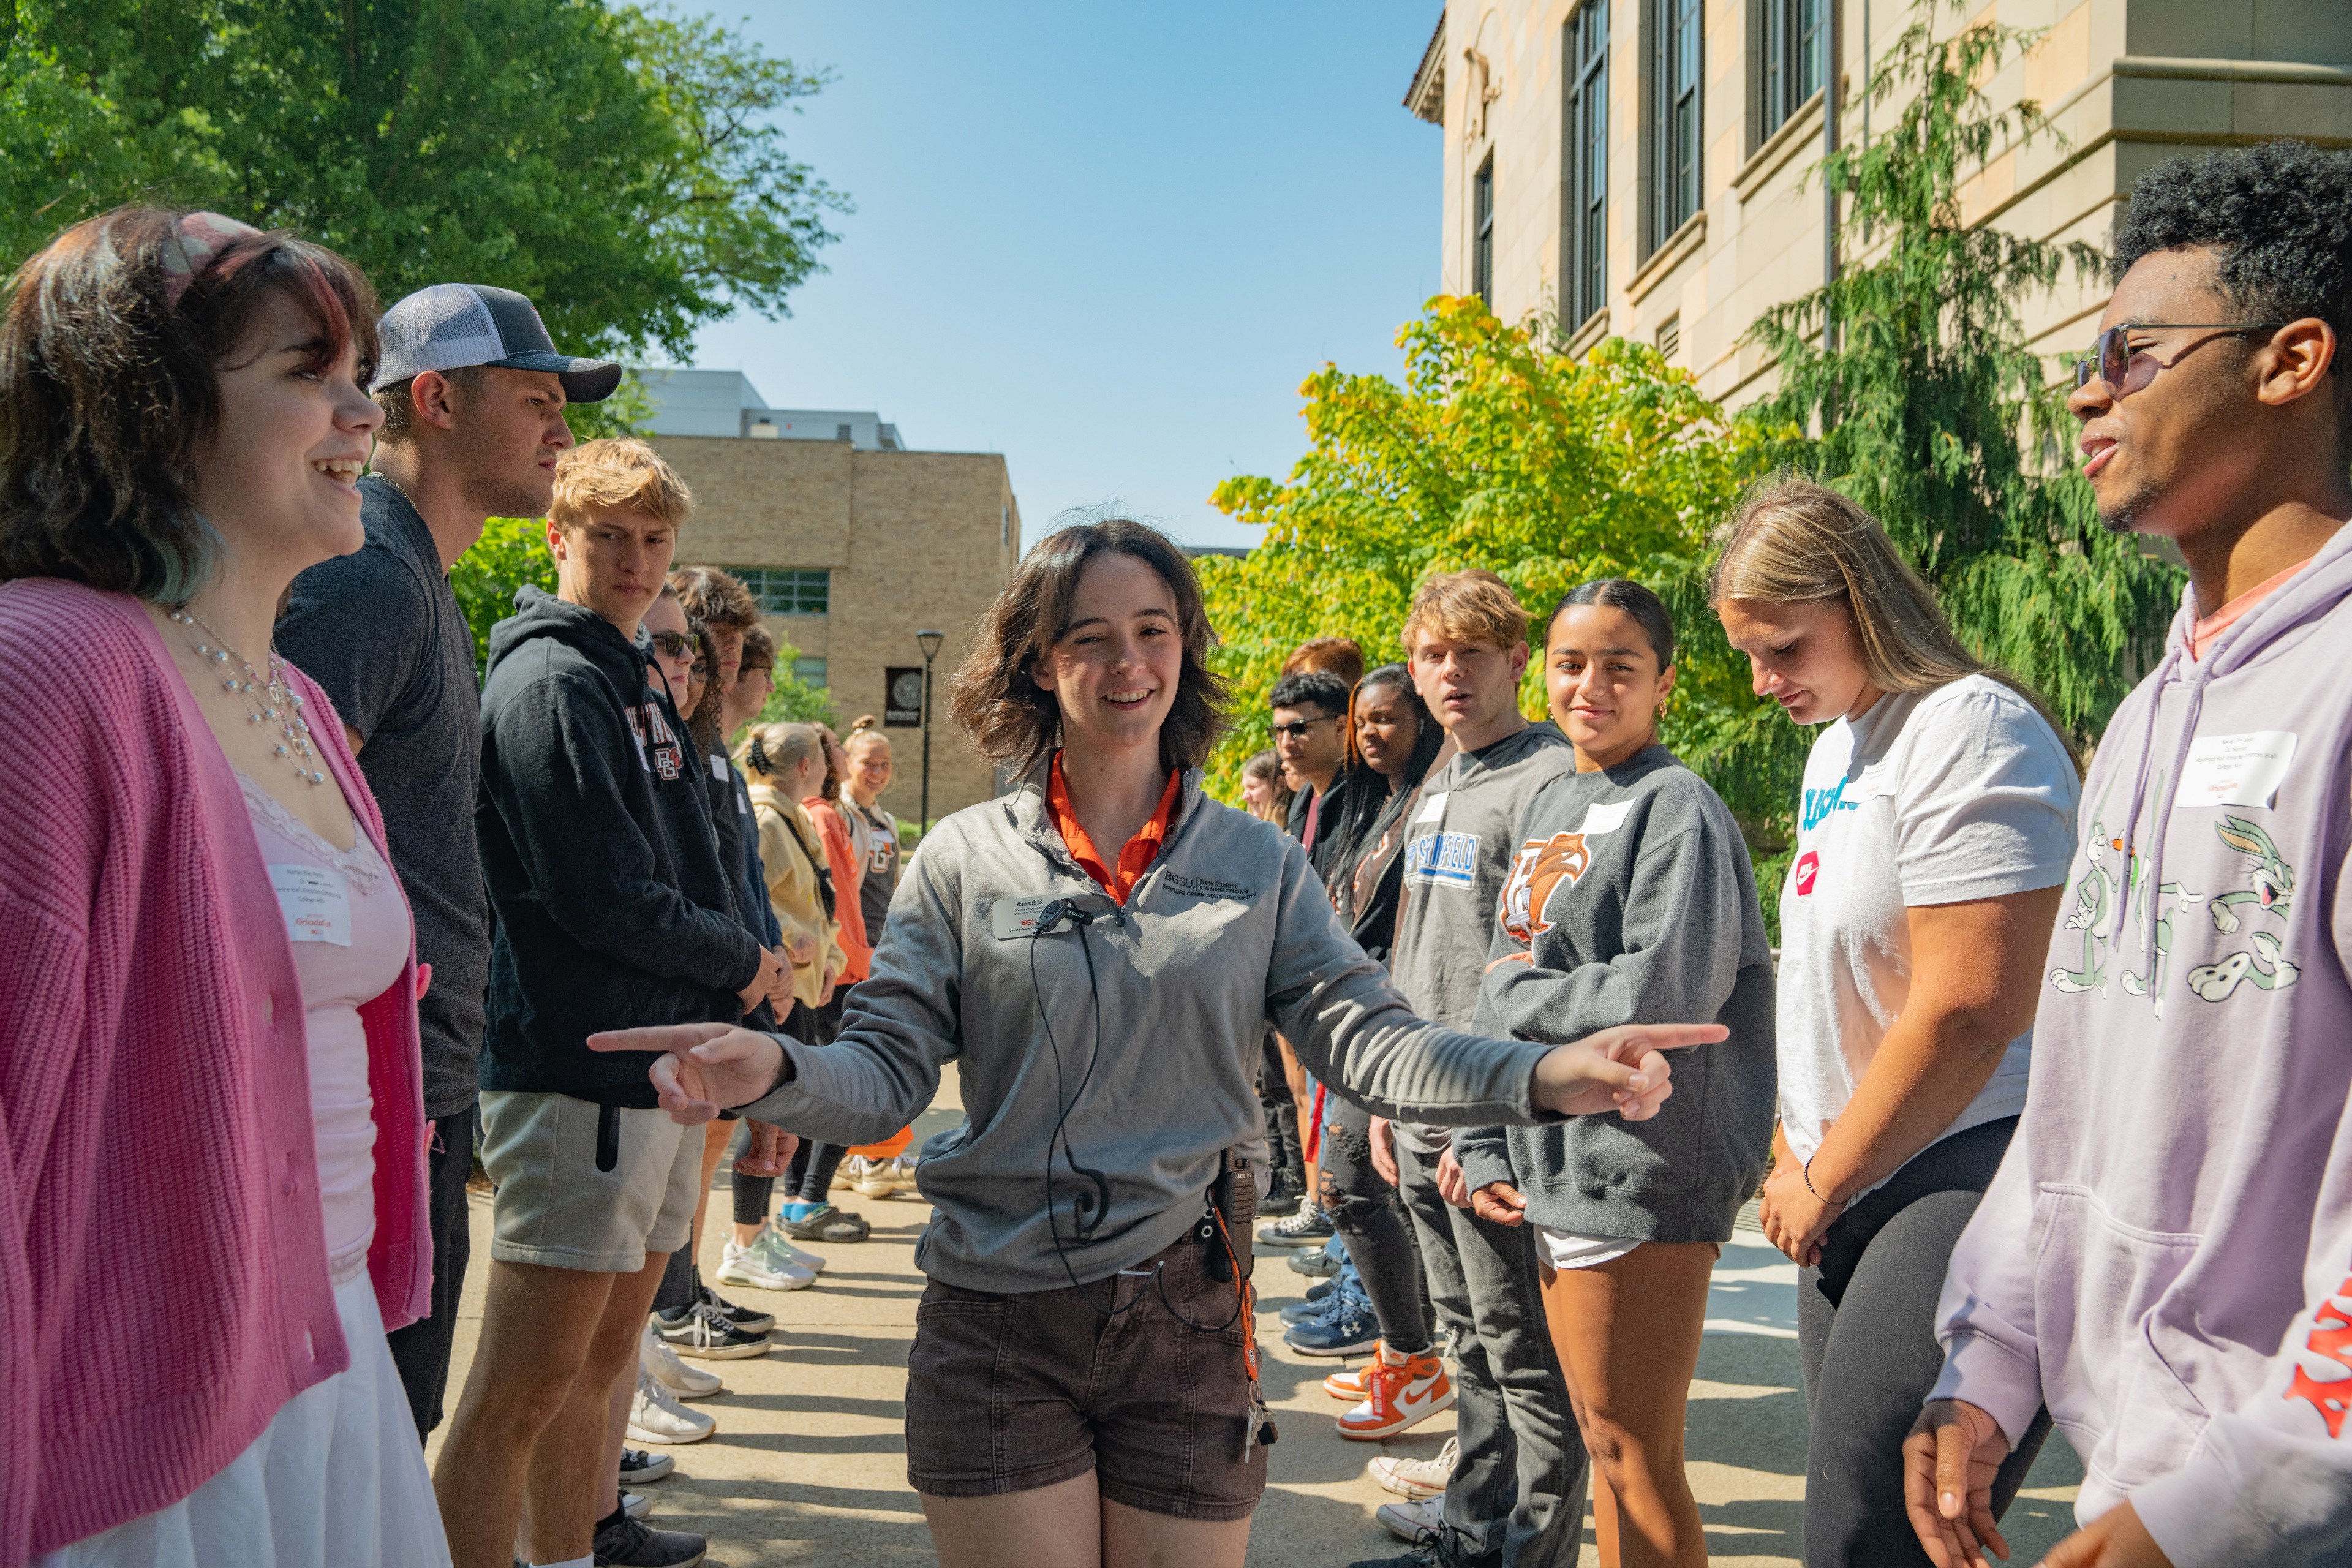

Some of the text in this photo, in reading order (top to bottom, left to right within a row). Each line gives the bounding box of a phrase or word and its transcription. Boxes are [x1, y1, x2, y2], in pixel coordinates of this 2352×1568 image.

[1799, 862, 1813, 876] NIKE
[1162, 883, 1185, 895] BOWLING
[1225, 892, 1257, 900] UNIVERSITY
[1372, 1378, 1382, 1413] FLIGHT CLUB
